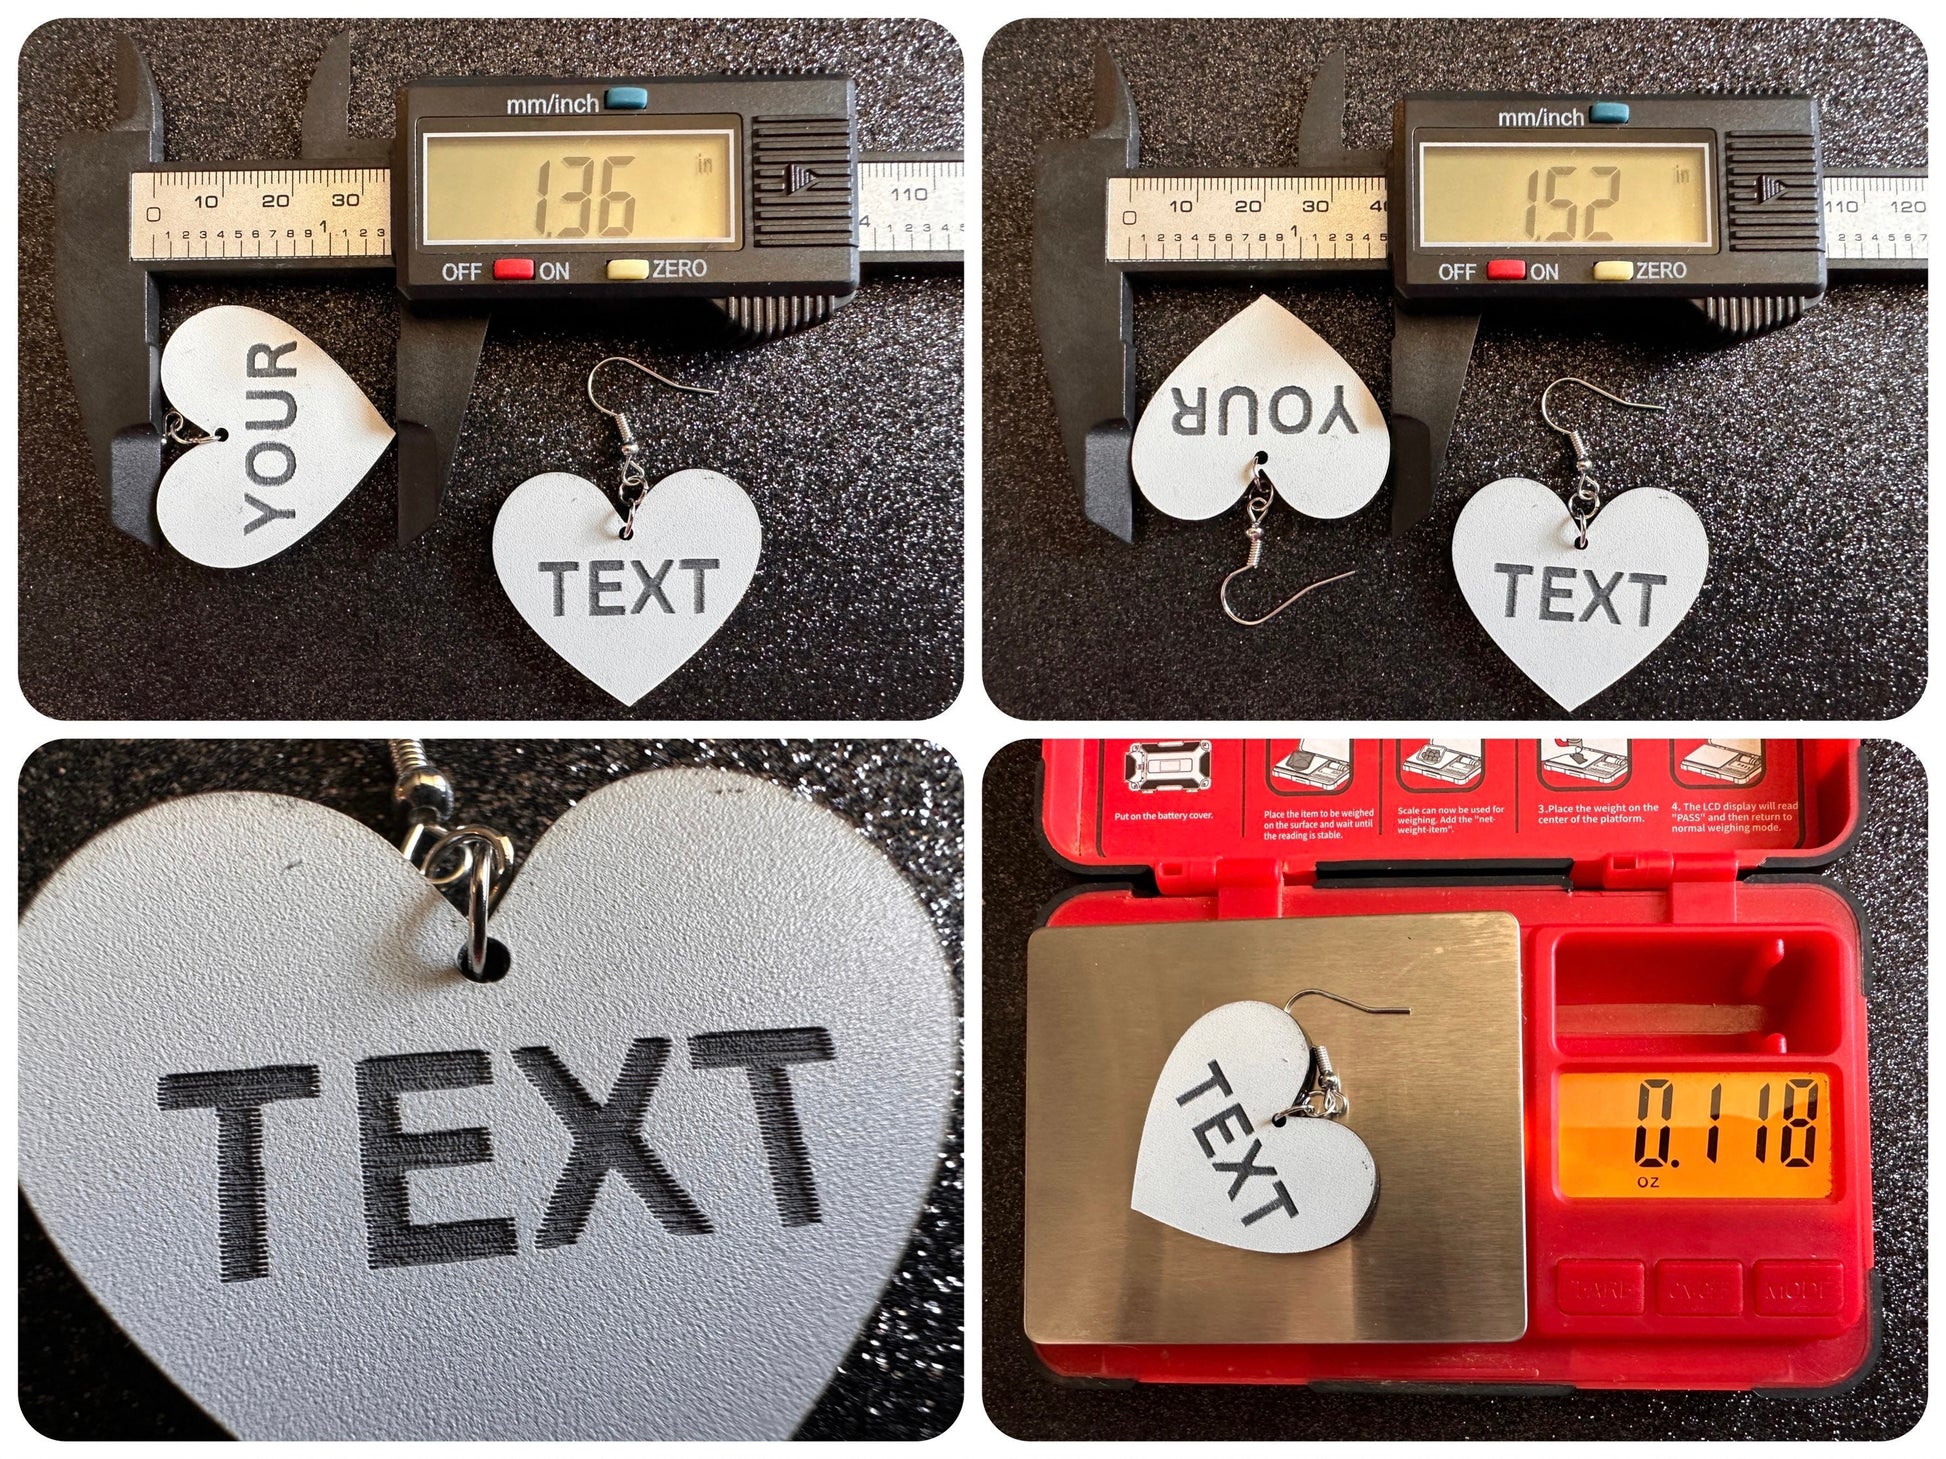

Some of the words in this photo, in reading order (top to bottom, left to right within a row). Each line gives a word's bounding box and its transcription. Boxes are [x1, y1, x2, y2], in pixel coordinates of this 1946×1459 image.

[507, 94, 599, 115] mm/inch
[1498, 107, 1585, 127] mm/inch
[1675, 164, 1690, 184] in
[535, 155, 636, 238] 1.36
[697, 153, 713, 174] in
[891, 187, 928, 201] 110
[145, 206, 162, 222] 0
[194, 195, 219, 209] 10
[262, 194, 290, 208] 20
[332, 193, 360, 207] 30
[1122, 210, 1138, 225] 0
[1169, 200, 1193, 213] 10
[1235, 200, 1262, 213] 20
[1302, 200, 1330, 213] 30
[1825, 200, 1859, 213] 110
[1890, 200, 1927, 213] 120
[165, 231, 171, 240] 1
[182, 230, 190, 239] 2
[199, 230, 208, 239] 3
[216, 230, 225, 239] 4
[234, 230, 243, 239] 5
[251, 229, 260, 239] 6
[269, 229, 277, 239] 7
[286, 229, 295, 239] 8
[303, 229, 313, 239] 9
[319, 220, 327, 234] 1
[342, 229, 348, 238] 1
[360, 229, 368, 238] 2
[376, 228, 386, 238] 3
[859, 215, 871, 228] 4
[887, 224, 892, 232] 1
[905, 223, 913, 232] 2
[923, 223, 931, 232] 3
[941, 223, 949, 232] 4
[1140, 233, 1146, 241] 1
[1157, 233, 1165, 242] 2
[1174, 233, 1182, 242] 3
[1191, 233, 1199, 242] 4
[1208, 233, 1216, 242] 5
[1225, 233, 1233, 242] 6
[1241, 233, 1250, 242] 7
[1258, 233, 1267, 242] 8
[1275, 233, 1284, 242] 9
[1290, 225, 1297, 237] 1
[1311, 233, 1317, 241] 1
[1328, 233, 1337, 242] 2
[1345, 233, 1354, 242] 3
[1362, 233, 1371, 242] 4
[1379, 233, 1388, 242] 5
[1838, 233, 1846, 242] 2
[1855, 233, 1863, 242] 3
[1871, 233, 1880, 241] 4
[1888, 233, 1896, 242] 5
[1904, 233, 1912, 242] 6
[1920, 233, 1928, 241] 7
[442, 263, 482, 281] OFF
[539, 262, 570, 280] ON
[652, 259, 707, 279] ZERO
[1438, 263, 1477, 281] OFF
[1530, 263, 1560, 281] ON
[1636, 261, 1687, 280] ZERO
[1171, 384, 1361, 437] YOUR
[243, 340, 299, 537] YOUR
[537, 558, 720, 617] TEXT
[1493, 562, 1668, 628] TEXT
[1115, 812, 1129, 820] Put
[1142, 812, 1156, 820] the
[1158, 811, 1187, 821] battery
[1189, 811, 1213, 819] cover.
[1264, 810, 1285, 819] Place
[1286, 809, 1299, 818] the
[1301, 809, 1319, 818] item
[1320, 810, 1328, 818] to
[1330, 809, 1340, 817] be
[1341, 808, 1374, 819] weighed
[1398, 806, 1420, 814] Scale
[1492, 805, 1504, 813] for
[1575, 804, 1592, 813] the
[1593, 803, 1626, 814] weight
[1628, 804, 1641, 812] on
[1643, 803, 1659, 812] the
[1671, 802, 1681, 811] 4.
[1683, 802, 1701, 811] The
[1703, 802, 1721, 811] LCD
[1723, 801, 1757, 812] display
[1759, 801, 1776, 810] will
[1777, 801, 1799, 810] read
[1275, 821, 1289, 829] the
[1290, 820, 1318, 829] surface
[1319, 819, 1334, 828] and
[1336, 819, 1353, 828] wait
[1355, 819, 1373, 828] until
[1439, 816, 1457, 824] Add
[1458, 815, 1473, 824] the
[1538, 816, 1568, 824] center
[1570, 815, 1581, 824] of
[1582, 815, 1598, 823] the
[1600, 814, 1645, 825] platform.
[1671, 813, 1706, 822] "PASS"
[1708, 813, 1726, 821] and
[1728, 813, 1749, 821] then
[1751, 813, 1780, 821] return
[1782, 813, 1793, 821] to
[1264, 832, 1277, 840] the
[1278, 831, 1308, 841] reading
[1309, 831, 1316, 839] is
[1317, 830, 1343, 839] stable.
[1671, 824, 1705, 833] normal
[1707, 823, 1750, 834] weighing
[1752, 823, 1782, 832] mode.
[1634, 1078, 1819, 1168] 0.118
[1175, 1058, 1300, 1228] TEXT
[156, 1026, 836, 1284] TEXT
[1764, 1279, 1834, 1299] MODE
